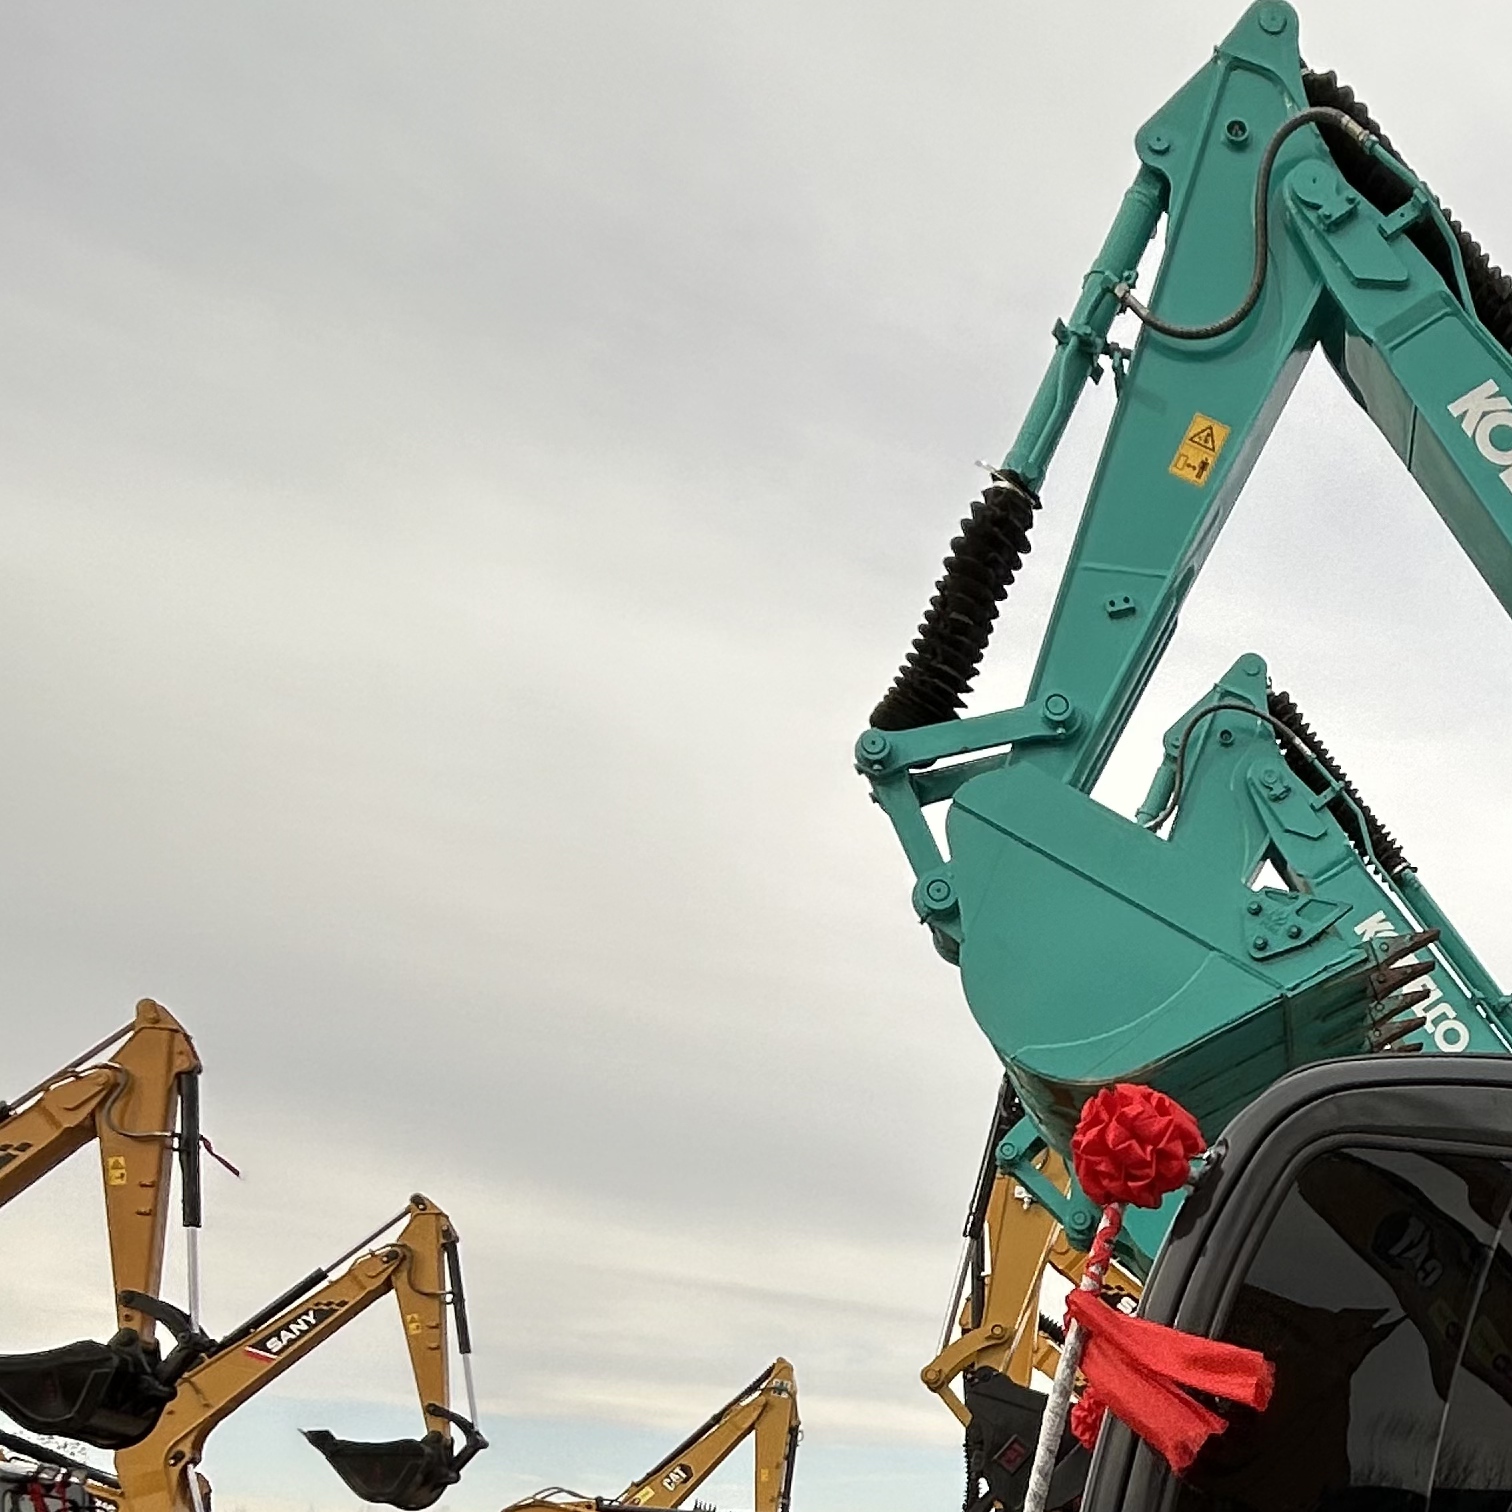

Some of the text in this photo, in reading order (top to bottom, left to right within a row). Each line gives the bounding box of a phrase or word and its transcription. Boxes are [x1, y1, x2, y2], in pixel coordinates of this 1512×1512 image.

[1354, 910, 1470, 1053] KLCO
[266, 1310, 316, 1352] SANY
[662, 1465, 688, 1491] CAT
